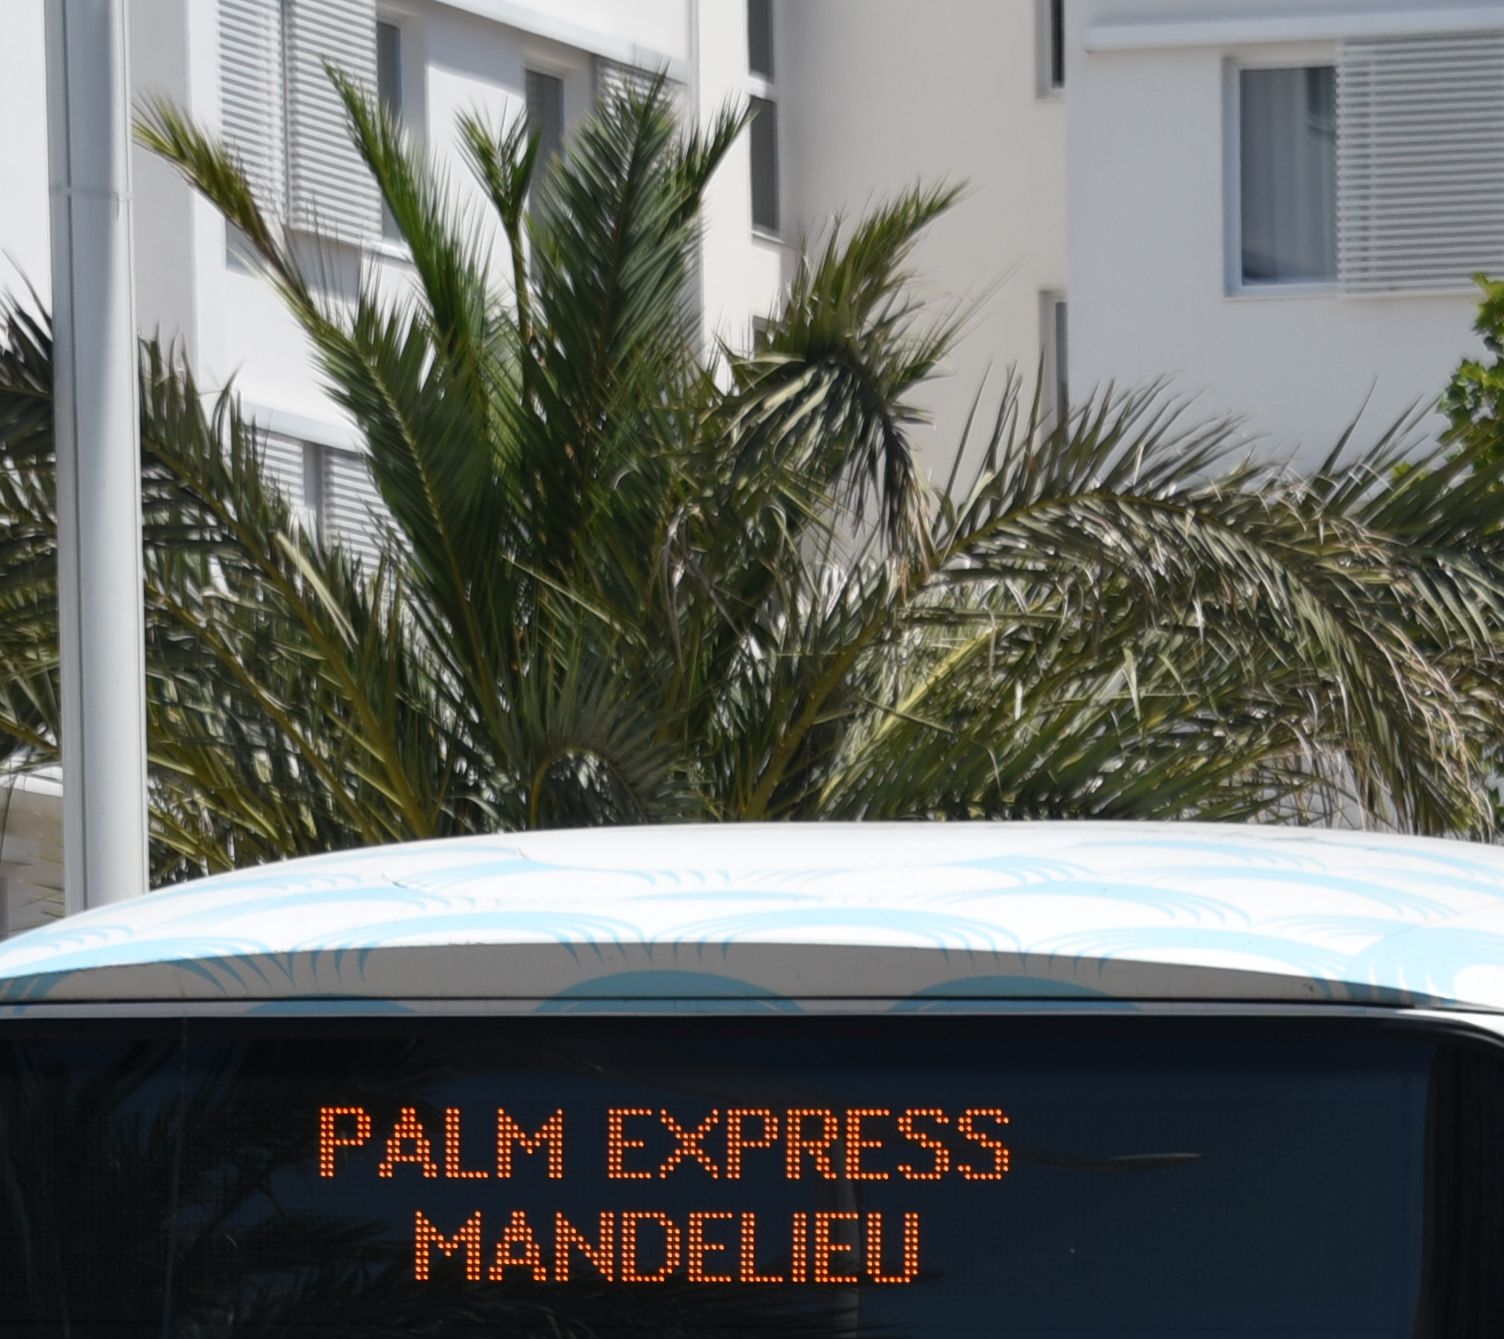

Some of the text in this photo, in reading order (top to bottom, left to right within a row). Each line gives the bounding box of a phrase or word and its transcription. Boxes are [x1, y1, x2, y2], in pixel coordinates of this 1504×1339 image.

[318, 1106, 1012, 1181] PALM EXPRESS
[413, 1210, 921, 1285] MANDELIEU
